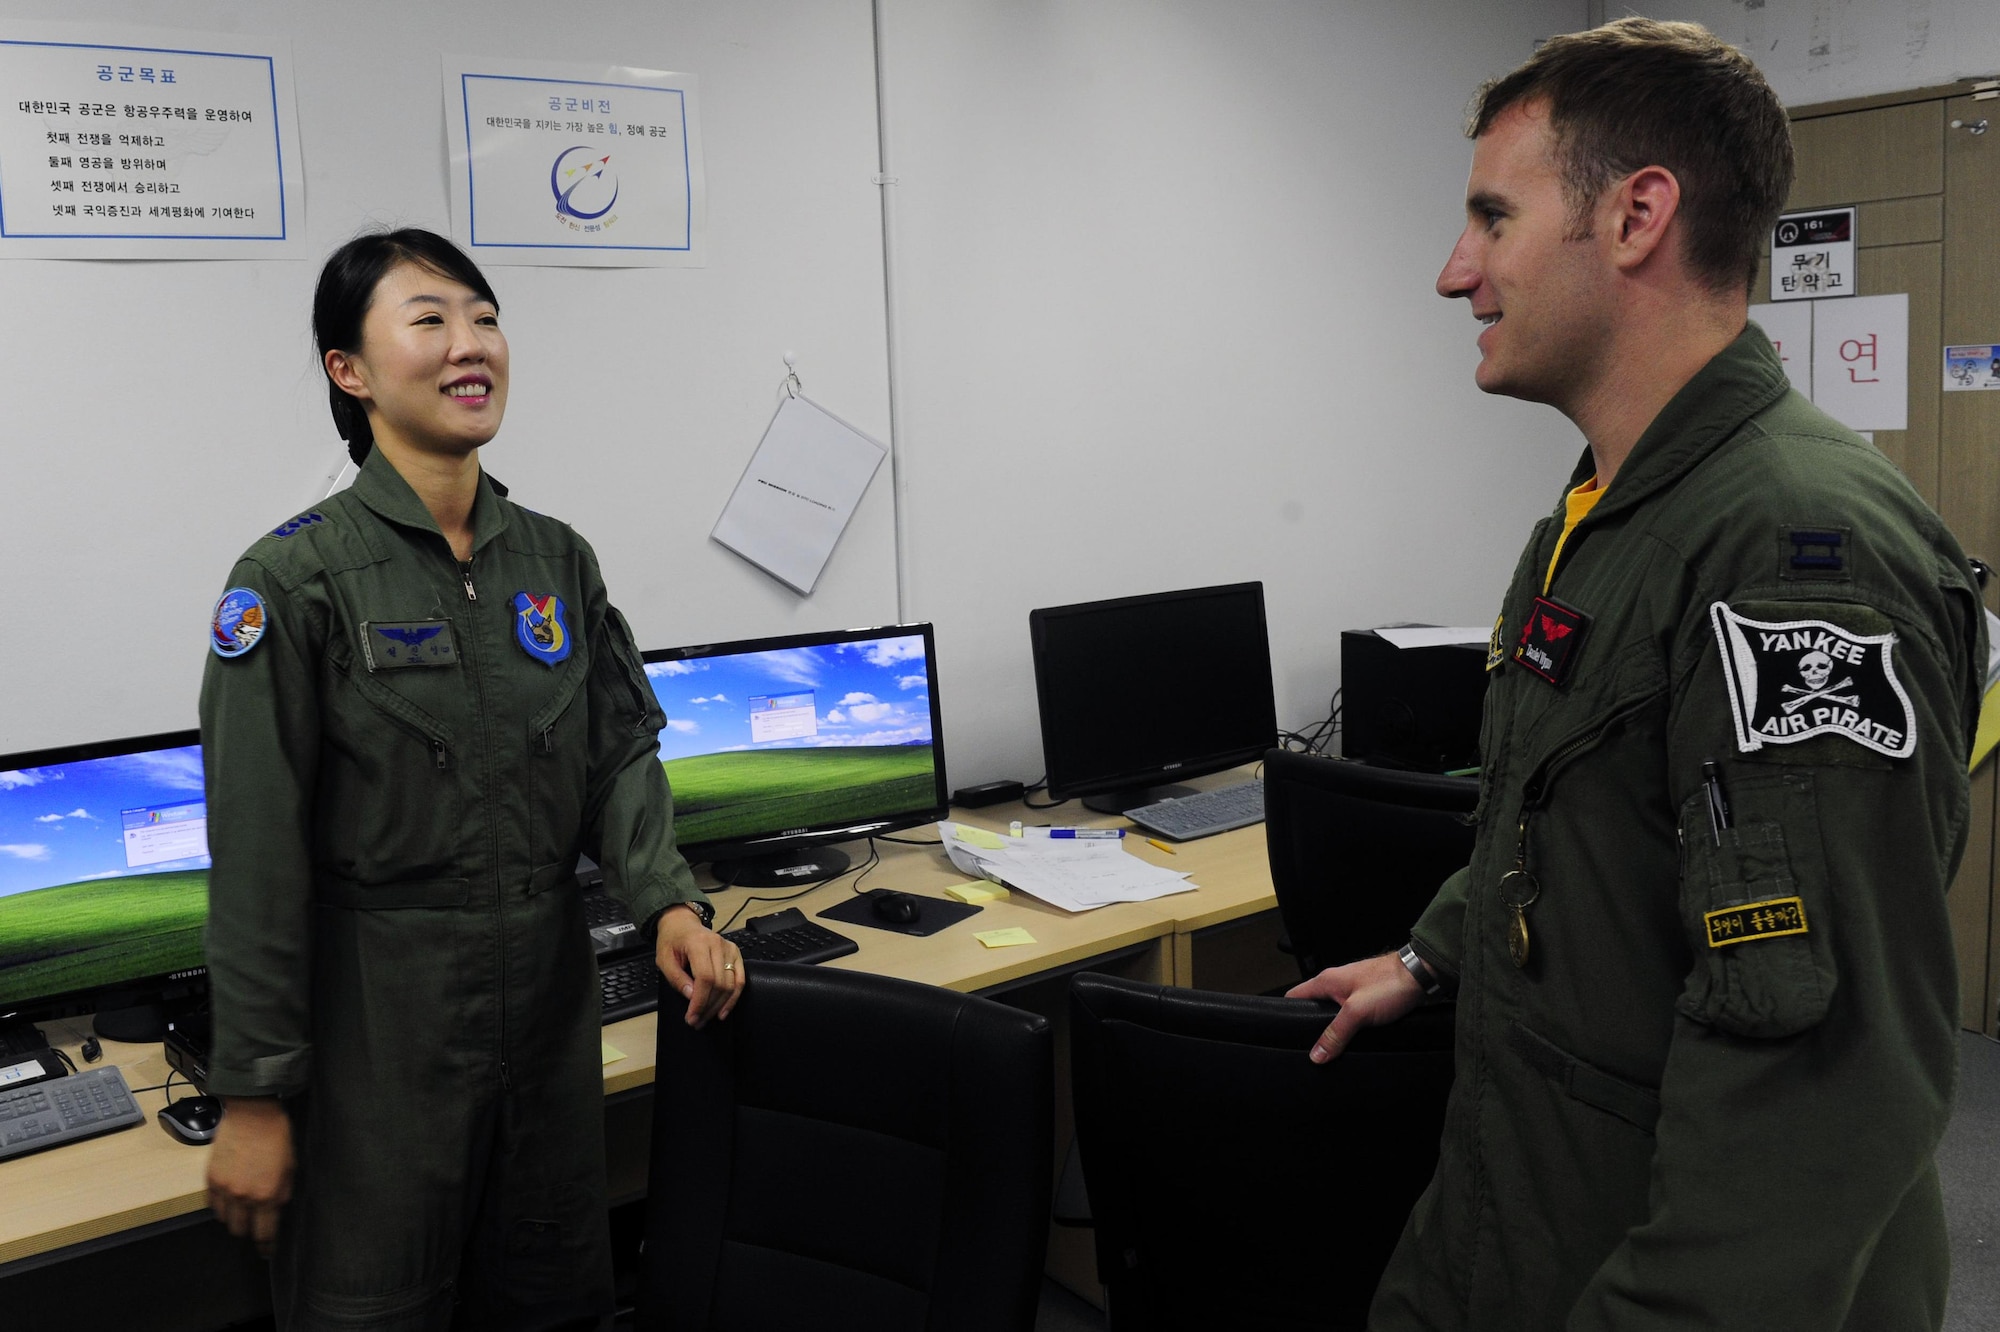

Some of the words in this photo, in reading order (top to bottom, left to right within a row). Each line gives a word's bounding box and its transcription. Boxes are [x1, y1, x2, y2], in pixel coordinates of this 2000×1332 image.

[96, 65, 177, 84] 공군목표
[19, 100, 71, 115] 대한민국
[78, 102, 117, 117] 공군은
[123, 104, 198, 121] 항공우주력을
[204, 108, 252, 123] 운영하여
[548, 96, 611, 115] 공군비전
[486, 116, 531, 130] 대한민국을
[535, 119, 562, 132] 지키는
[565, 121, 583, 133] 가장
[587, 122, 605, 134] 높은
[626, 124, 645, 137] 정예
[649, 125, 667, 138] 공군
[46, 131, 70, 145] 첫째
[77, 132, 112, 146] 전쟁을
[118, 134, 165, 147] 억제하고
[48, 156, 72, 168] 둘째
[79, 157, 114, 170] 영공을
[120, 158, 167, 171] 방위하며
[50, 180, 74, 192] 셋째
[81, 181, 128, 194] 전쟁에서
[134, 182, 181, 194] 승리하고
[52, 204, 76, 217] 넷째
[83, 205, 142, 217] 국익증진과
[148, 206, 205, 219] 세계평화에
[211, 207, 255, 220] 기여한다
[1803, 220, 1823, 230] 161
[1839, 333, 1880, 383] 연
[1758, 630, 1866, 666] YANKEE
[1761, 713, 1810, 736] AIR
[1812, 706, 1904, 749] PIRATE
